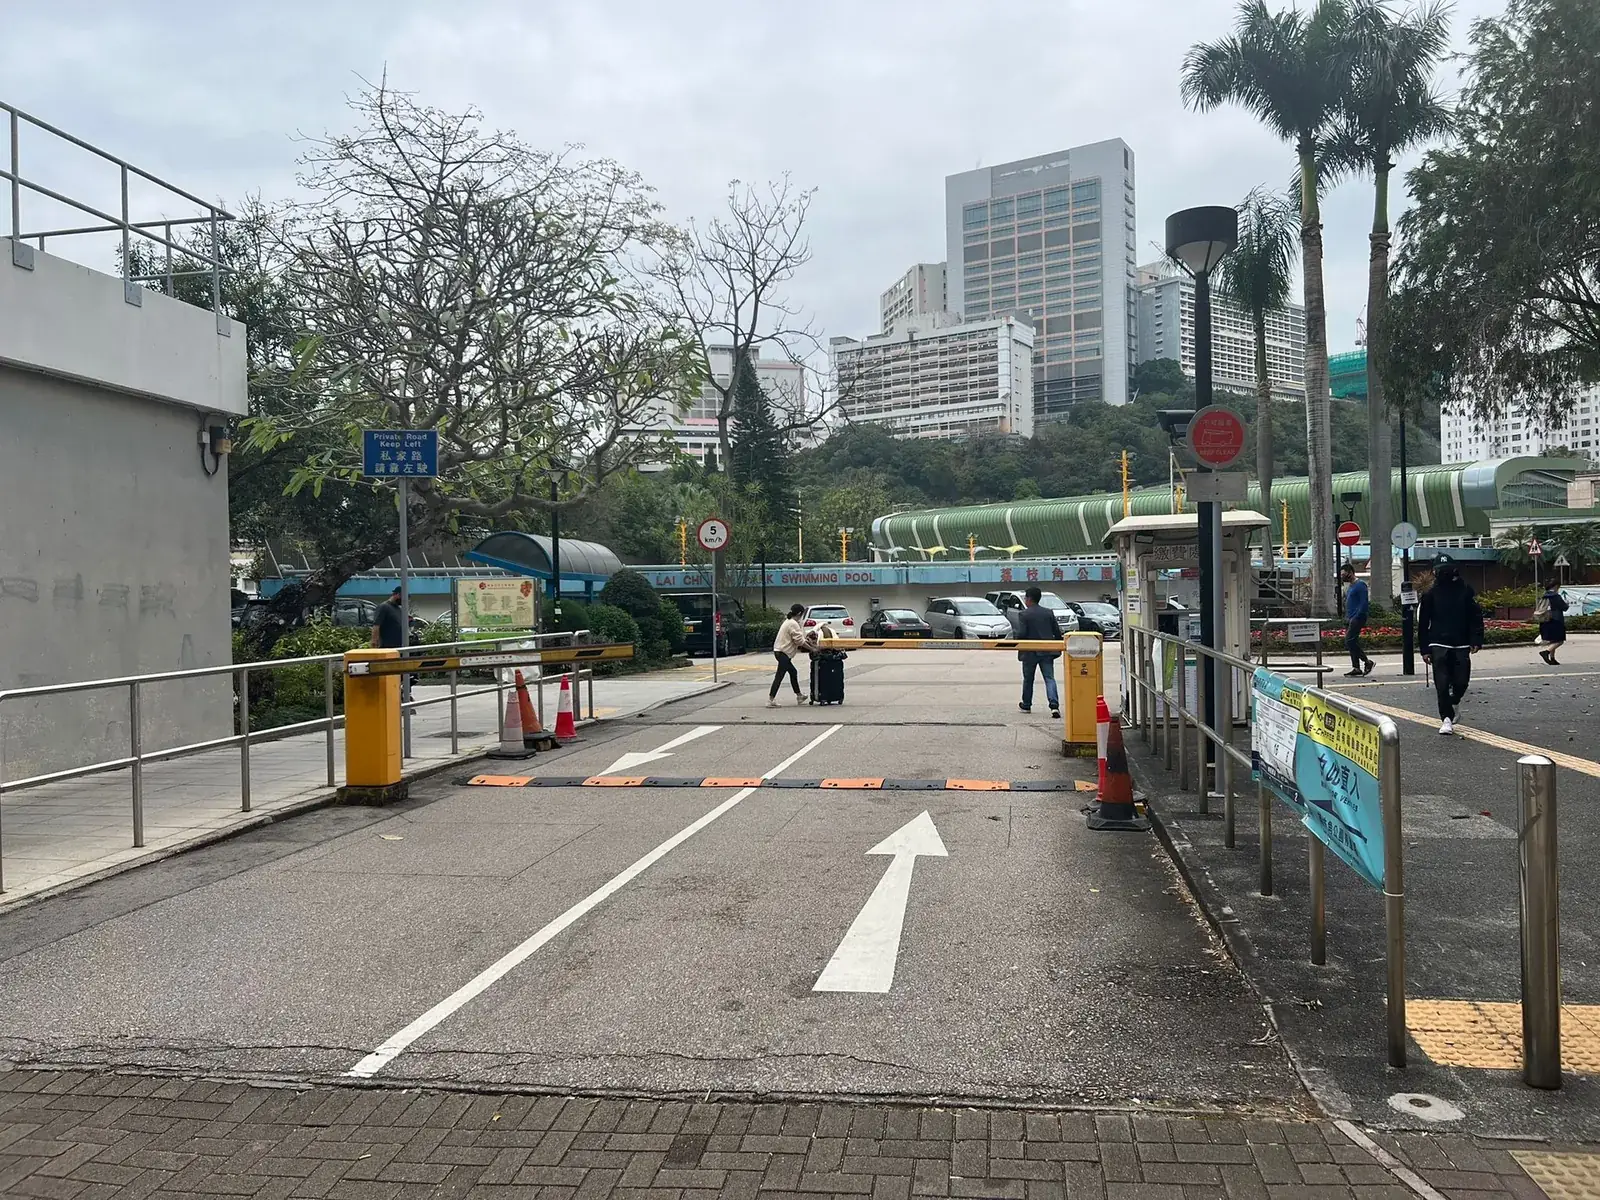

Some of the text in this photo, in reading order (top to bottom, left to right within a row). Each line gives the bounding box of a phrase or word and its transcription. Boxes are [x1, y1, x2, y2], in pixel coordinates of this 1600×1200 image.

[374, 433, 427, 441] Private Road
[380, 450, 422, 461] 私家路
[375, 463, 428, 474] 請靠左駛
[710, 526, 717, 535] 5
[656, 575, 676, 585] LAI
[683, 575, 702, 585] CHI
[781, 573, 838, 584] SWIMMING
[845, 572, 876, 583] POOL
